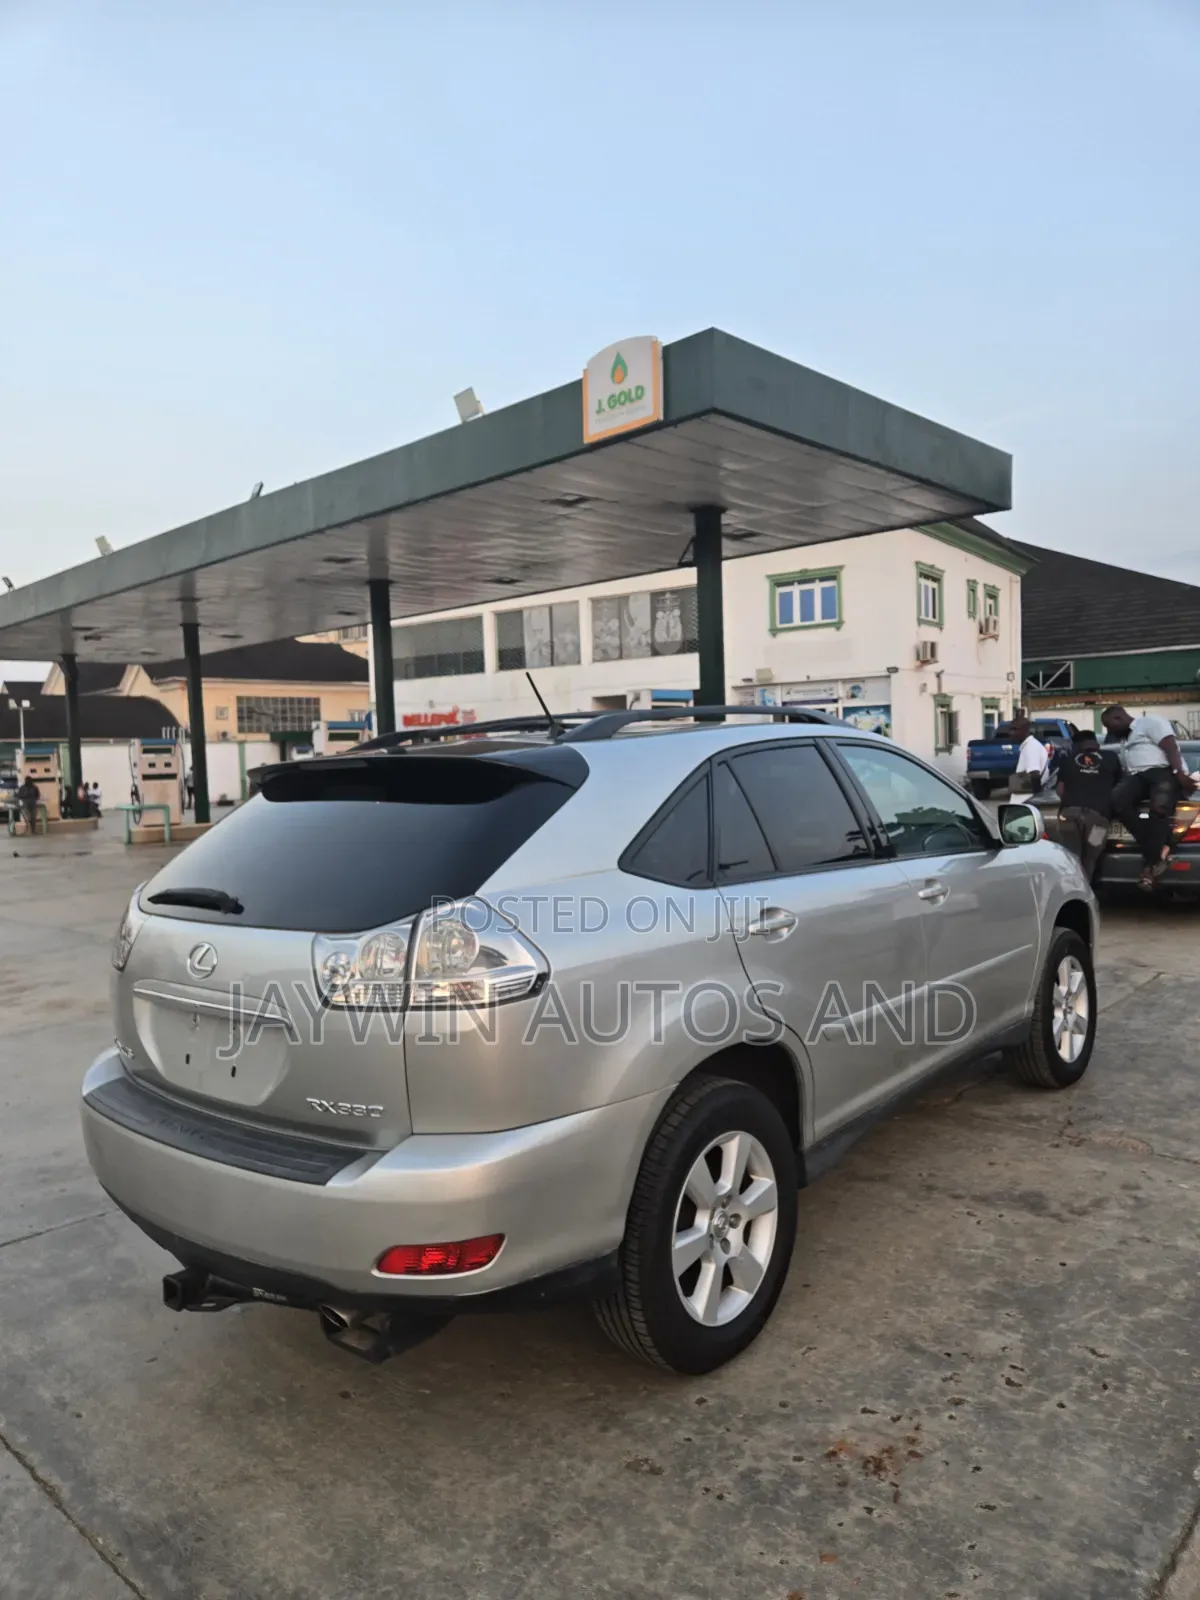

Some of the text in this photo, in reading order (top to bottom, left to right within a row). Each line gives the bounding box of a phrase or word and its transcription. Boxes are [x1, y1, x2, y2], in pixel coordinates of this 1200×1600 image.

[596, 399, 605, 415] J.
[607, 385, 645, 409] GOLD
[306, 1097, 384, 1118] RX330
